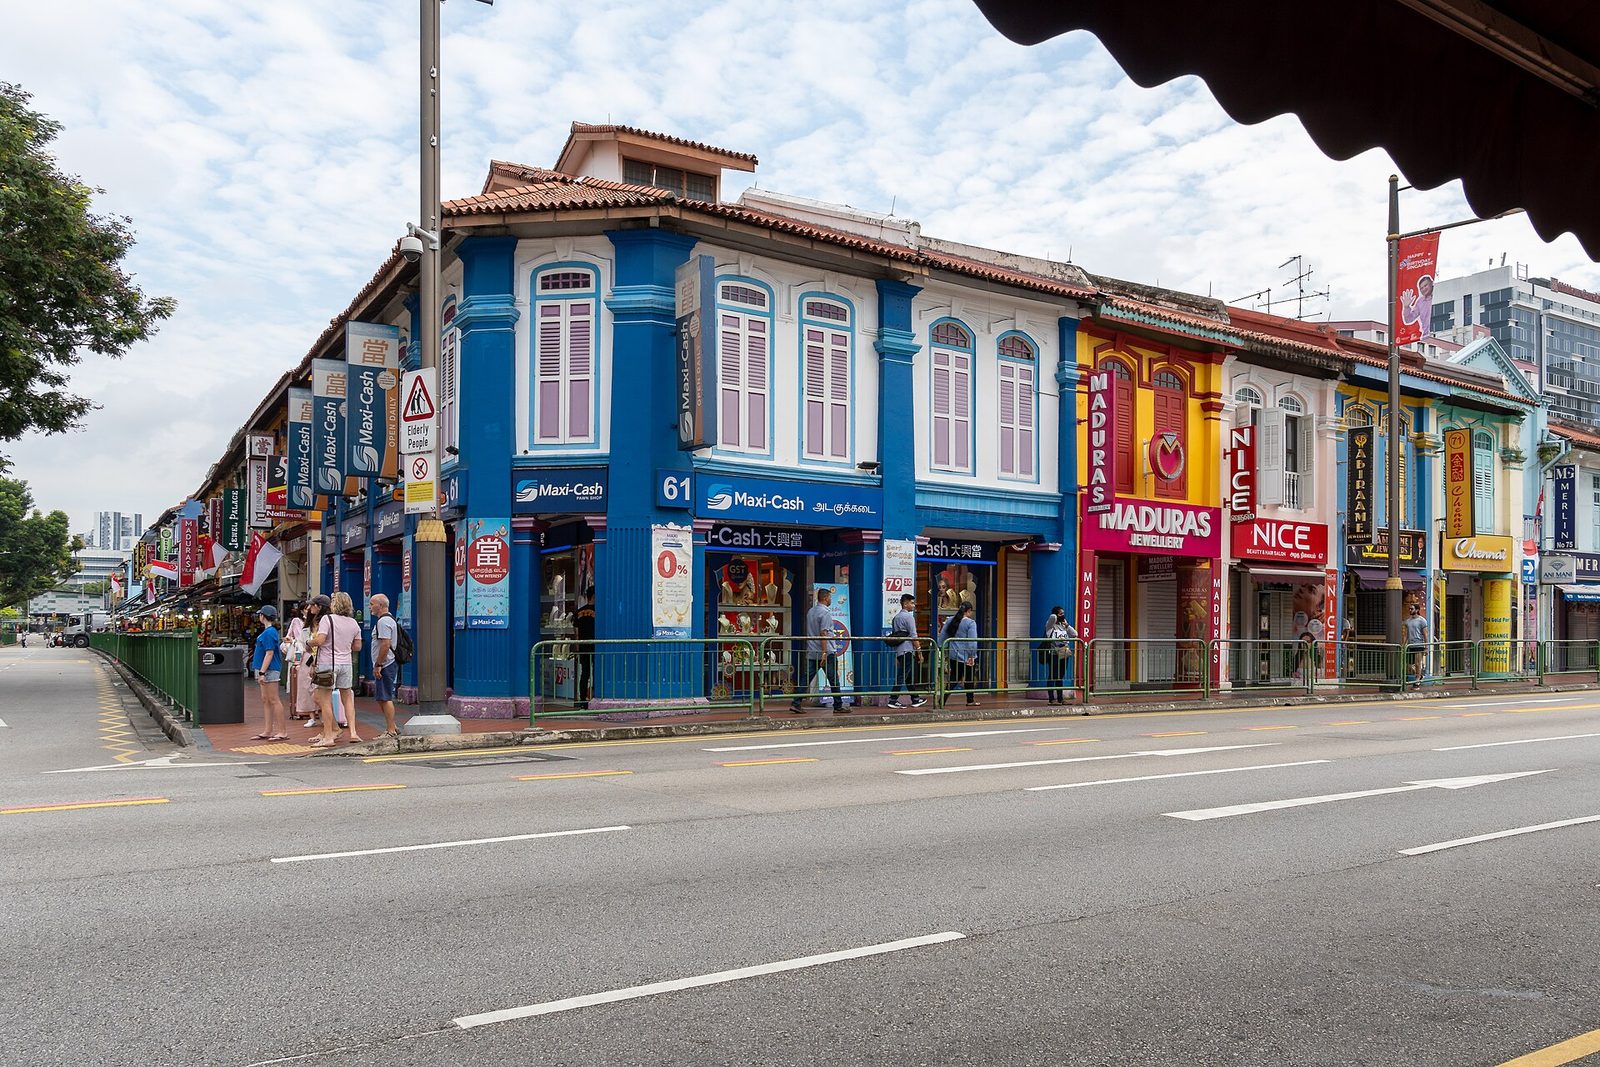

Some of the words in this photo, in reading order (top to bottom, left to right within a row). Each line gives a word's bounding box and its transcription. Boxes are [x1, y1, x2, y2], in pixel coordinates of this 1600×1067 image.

[681, 321, 691, 410] Maxi-Cash
[360, 370, 374, 445] Maxi-Cash
[324, 402, 336, 467] Maxi-Cash
[389, 423, 397, 448] OPEN
[408, 424, 429, 436] Elderly
[408, 437, 428, 450] People
[1091, 373, 1108, 503] MADURAS
[1452, 436, 1461, 445] 71
[298, 426, 310, 485] Maxi-Cash
[1232, 428, 1250, 511] NICE
[450, 477, 458, 500] 61
[539, 483, 602, 496] Maxi-Cash
[664, 476, 690, 500] 61
[735, 491, 804, 510] Maxi-Cash
[1355, 449, 1366, 532] ABIRAAME
[229, 490, 238, 520] PALACE
[1452, 486, 1464, 536] Chennai
[1561, 483, 1569, 539] MERLIN
[1100, 504, 1211, 537] MADURAS
[229, 523, 238, 549] JEWEL
[707, 527, 760, 545] i-Cash
[764, 532, 802, 547] 大興當
[916, 541, 948, 556] Cash
[951, 544, 981, 558] 大興當
[1129, 534, 1184, 549] JEWELLERY
[1254, 522, 1310, 550] NICE
[1455, 538, 1506, 560] Chennai
[476, 538, 502, 566] 當
[657, 550, 687, 578] 0%
[1577, 558, 1598, 571] MER
[887, 578, 901, 590] 79
[1084, 572, 1092, 648] MADUR
